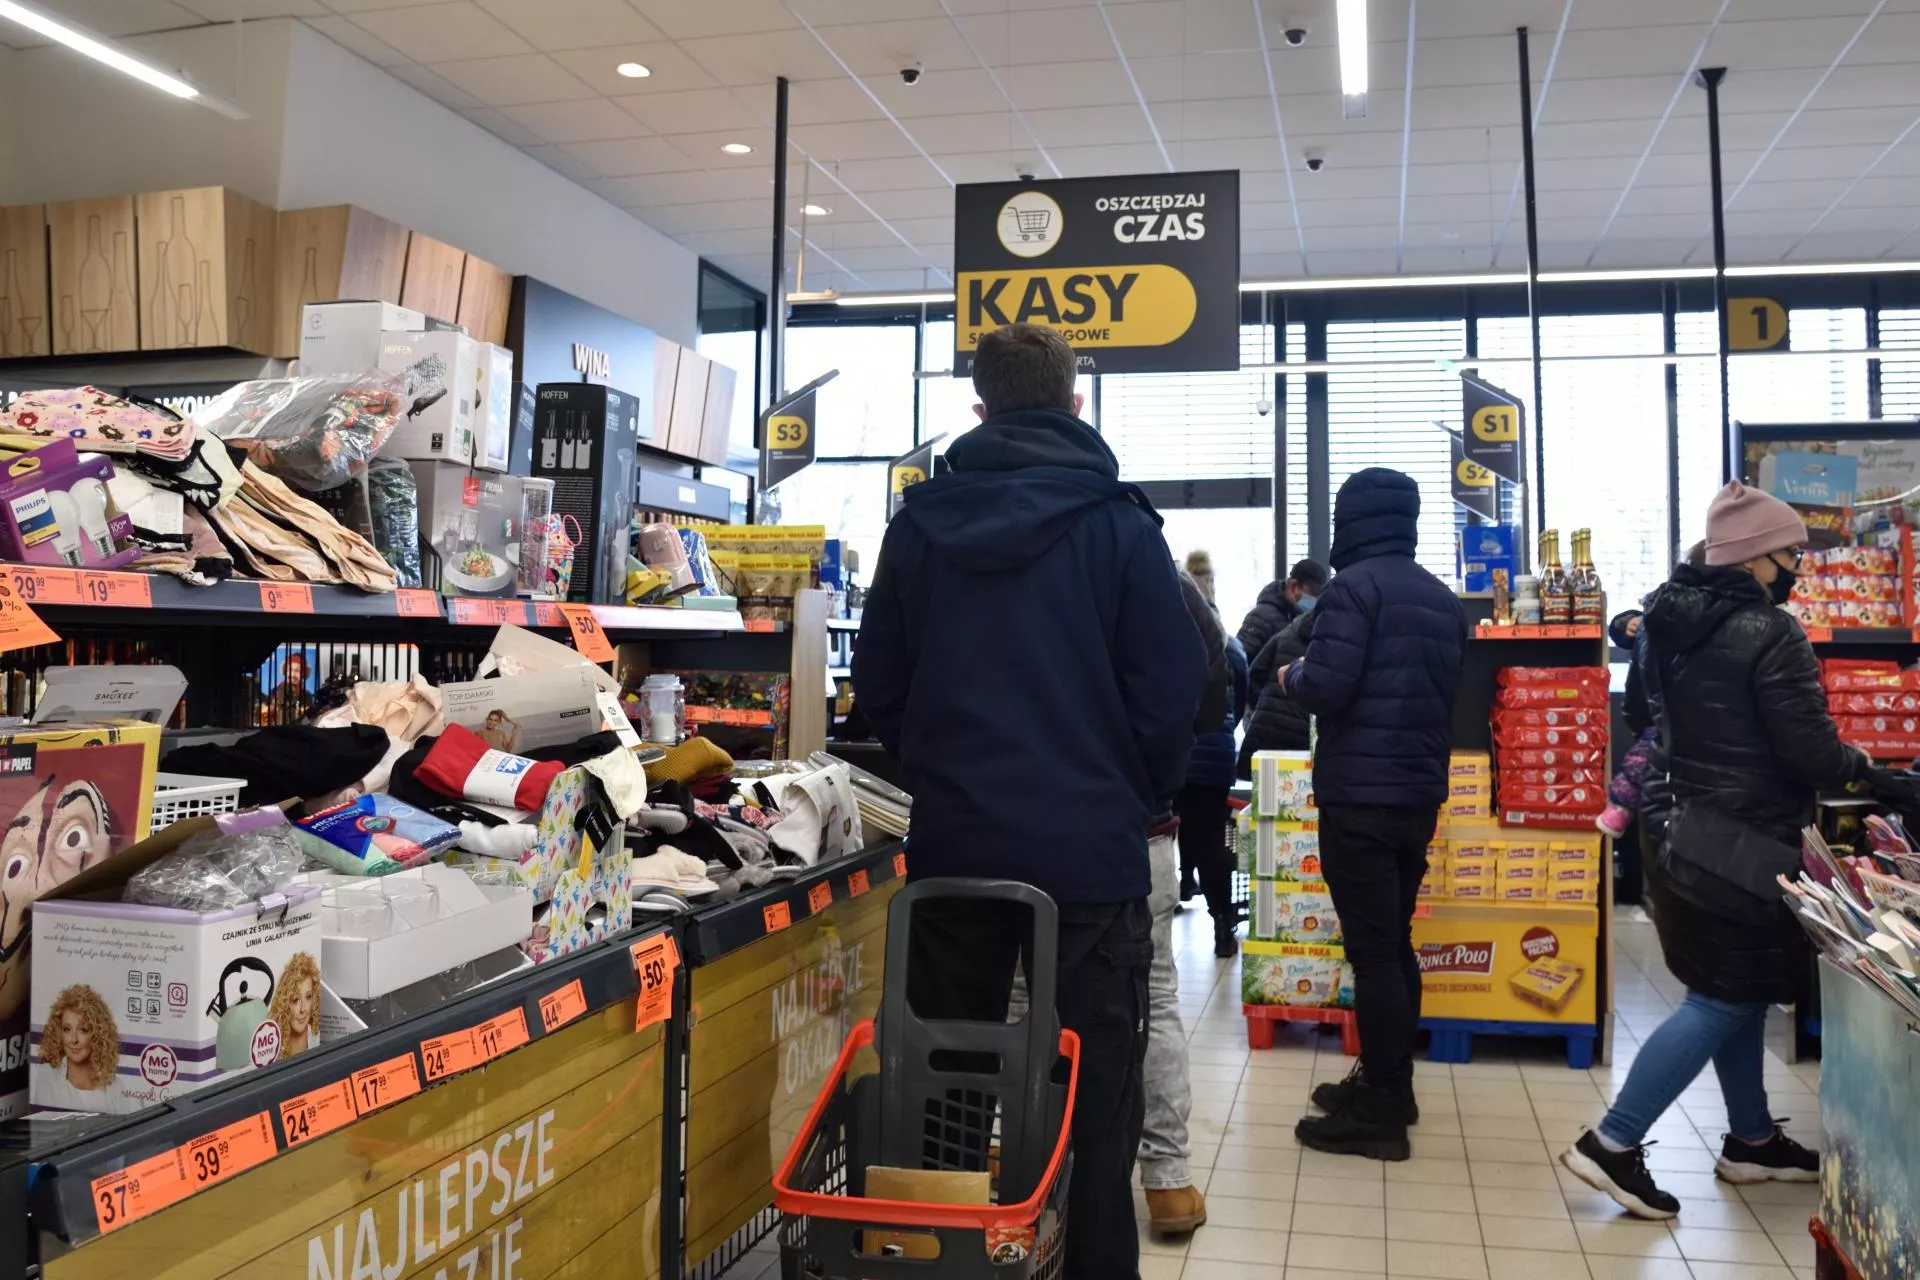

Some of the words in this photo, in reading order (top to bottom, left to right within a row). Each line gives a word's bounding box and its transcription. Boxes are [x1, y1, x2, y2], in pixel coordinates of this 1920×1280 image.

[1095, 193, 1206, 213] OSZCZĘDZAJ
[1113, 212, 1206, 243] CZAS
[968, 273, 1140, 327] KASY
[1752, 306, 1767, 340] 1
[573, 343, 610, 378] WINA
[541, 391, 568, 400] HOFFEN
[777, 424, 802, 441] S3
[1484, 414, 1509, 432] S1
[900, 473, 919, 486] S4
[1466, 465, 1489, 479] S2
[15, 497, 46, 514] PHILIPS
[14, 576, 36, 599] 29
[36, 577, 45, 587] 99
[88, 580, 108, 601] 19
[269, 590, 276, 609] 9
[448, 693, 464, 702] TOP
[464, 690, 494, 700] DAMSKI
[11, 757, 32, 771] PAPEL
[1303, 864, 1312, 873] 19
[1302, 883, 1325, 893] MEGA
[222, 928, 248, 941] CZAJNIK
[249, 926, 257, 934] ZE
[258, 922, 274, 932] STALI
[246, 938, 262, 948] LINIA
[264, 932, 286, 942] GALAXY
[287, 927, 301, 937] PURE
[1281, 946, 1305, 956] MEGA
[1309, 947, 1331, 956] PAKA
[1415, 951, 1452, 970] PRINCE
[1453, 944, 1488, 965] POLO
[545, 1007, 559, 1028] 44
[257, 1034, 274, 1048] MG
[482, 1031, 498, 1057] 11
[496, 1028, 502, 1038] 99
[149, 1055, 169, 1067] MG
[257, 1048, 274, 1058] home
[426, 1050, 444, 1077] 24
[443, 1048, 450, 1058] 99
[149, 1068, 169, 1076] home
[361, 1079, 378, 1108] 17
[379, 1076, 386, 1087] 99
[286, 1110, 309, 1143] 24
[307, 1106, 316, 1118] 99
[194, 1147, 220, 1182] 39
[219, 1141, 229, 1155] 99
[100, 1184, 126, 1224] 37
[129, 1180, 141, 1195] 99
[307, 1109, 555, 1280] NAJLEPSZE
